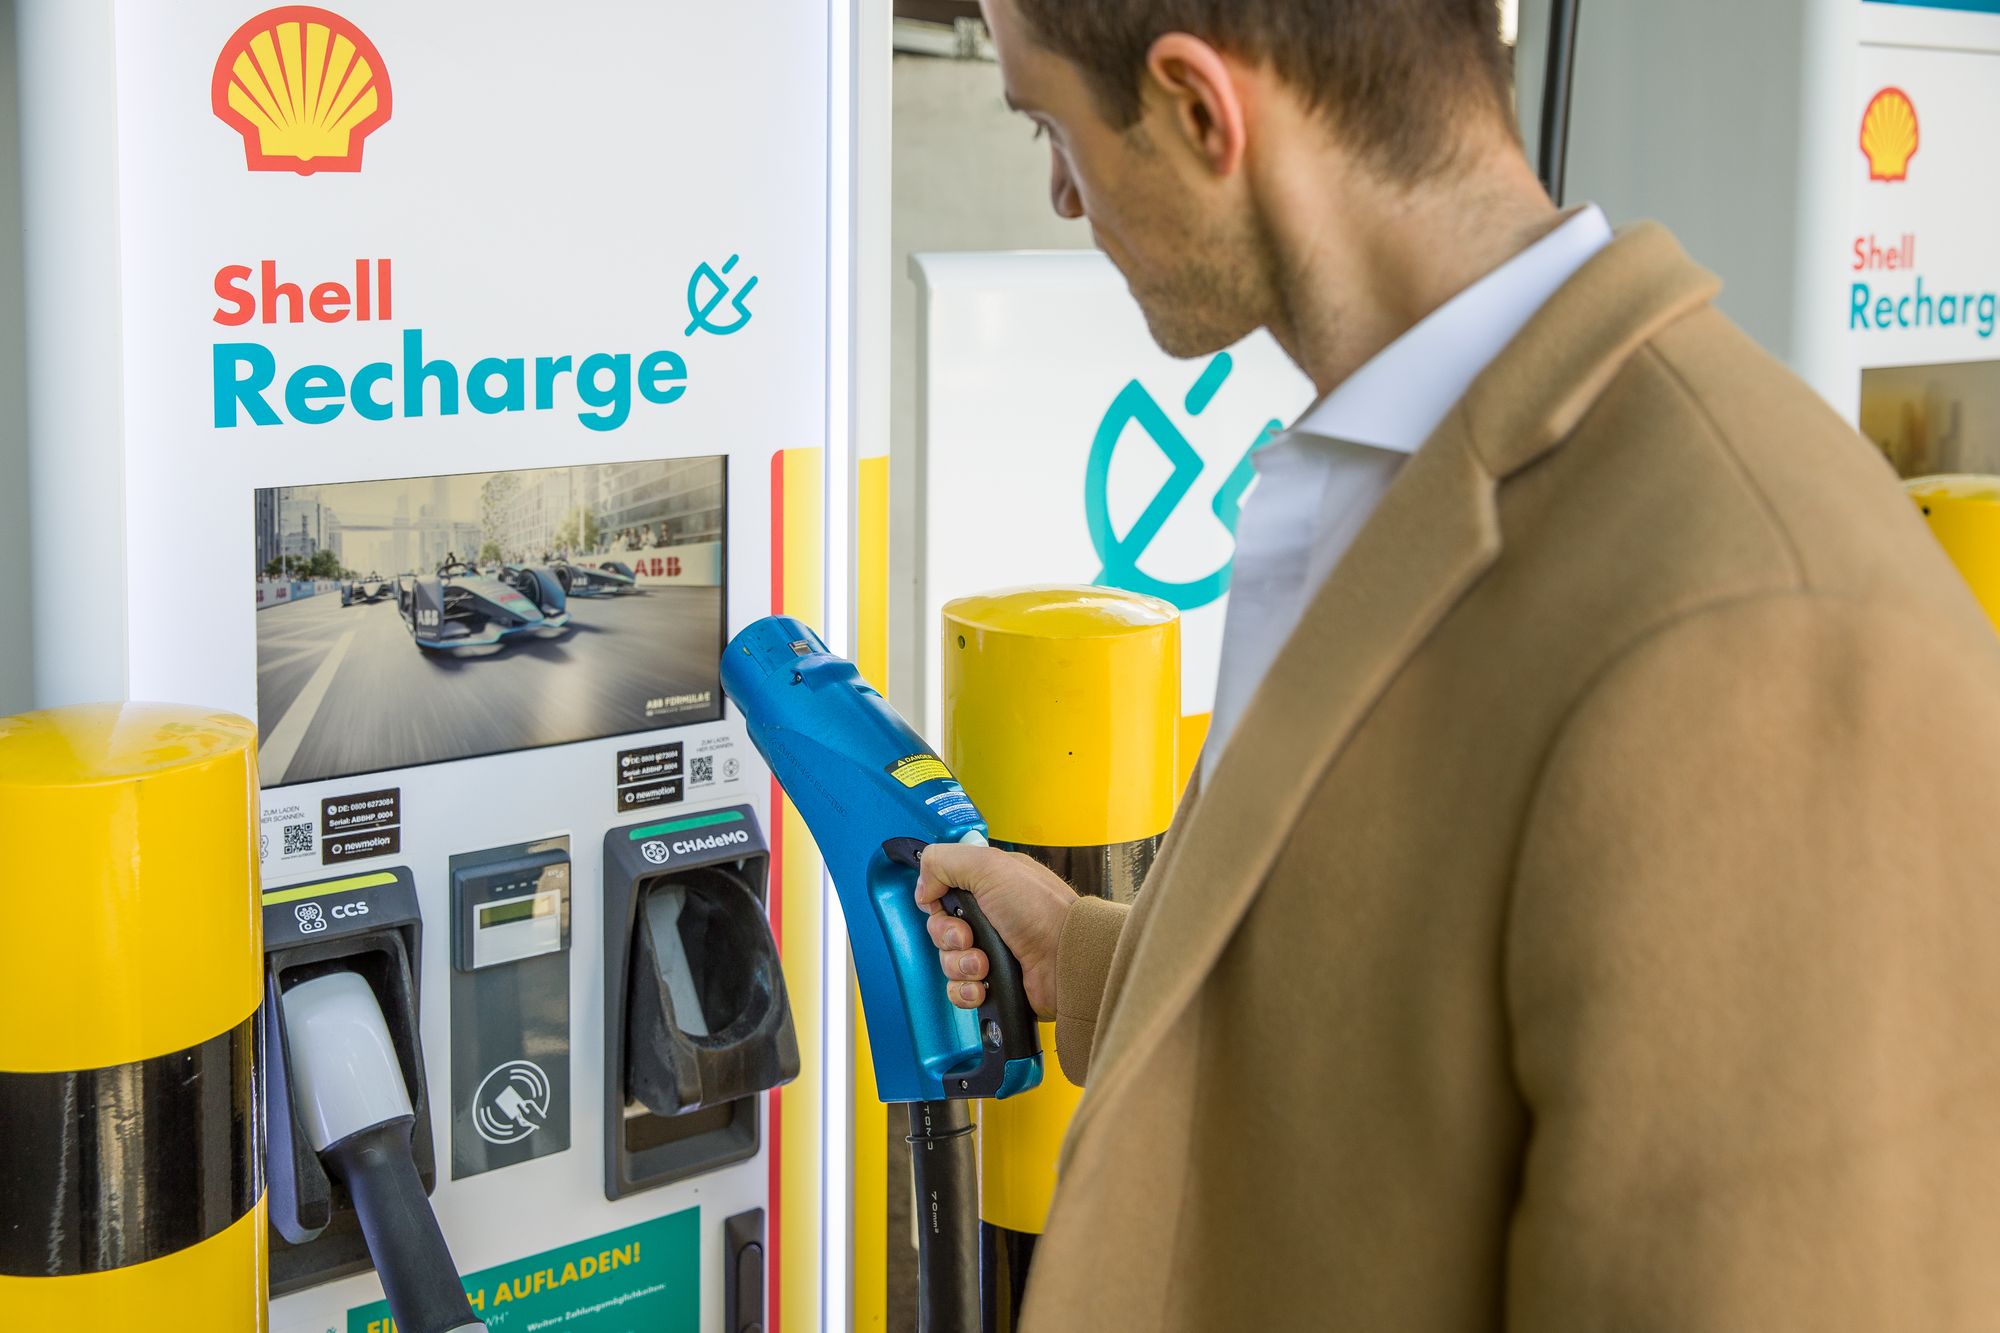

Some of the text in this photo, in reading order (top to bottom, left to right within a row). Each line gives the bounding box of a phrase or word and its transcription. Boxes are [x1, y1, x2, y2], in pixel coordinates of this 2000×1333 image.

[1853, 234, 1915, 270] Shell
[213, 258, 392, 326] Shell
[1850, 276, 2000, 337] Recharg
[213, 328, 688, 432] Recharge
[635, 556, 681, 577] ABB
[417, 609, 439, 626] ABB
[905, 754, 933, 763] DANGER
[636, 786, 675, 800] newmotion
[279, 805, 300, 815] LADEN
[338, 803, 350, 813] DE:
[351, 801, 367, 811] 0800
[329, 817, 351, 828] Serial:
[345, 837, 391, 851] newmotion
[672, 830, 749, 855] CHAdeMO
[331, 901, 369, 919] CCS
[493, 1241, 641, 1307] AUFLADEN!
[527, 1315, 563, 1332] Weitere
